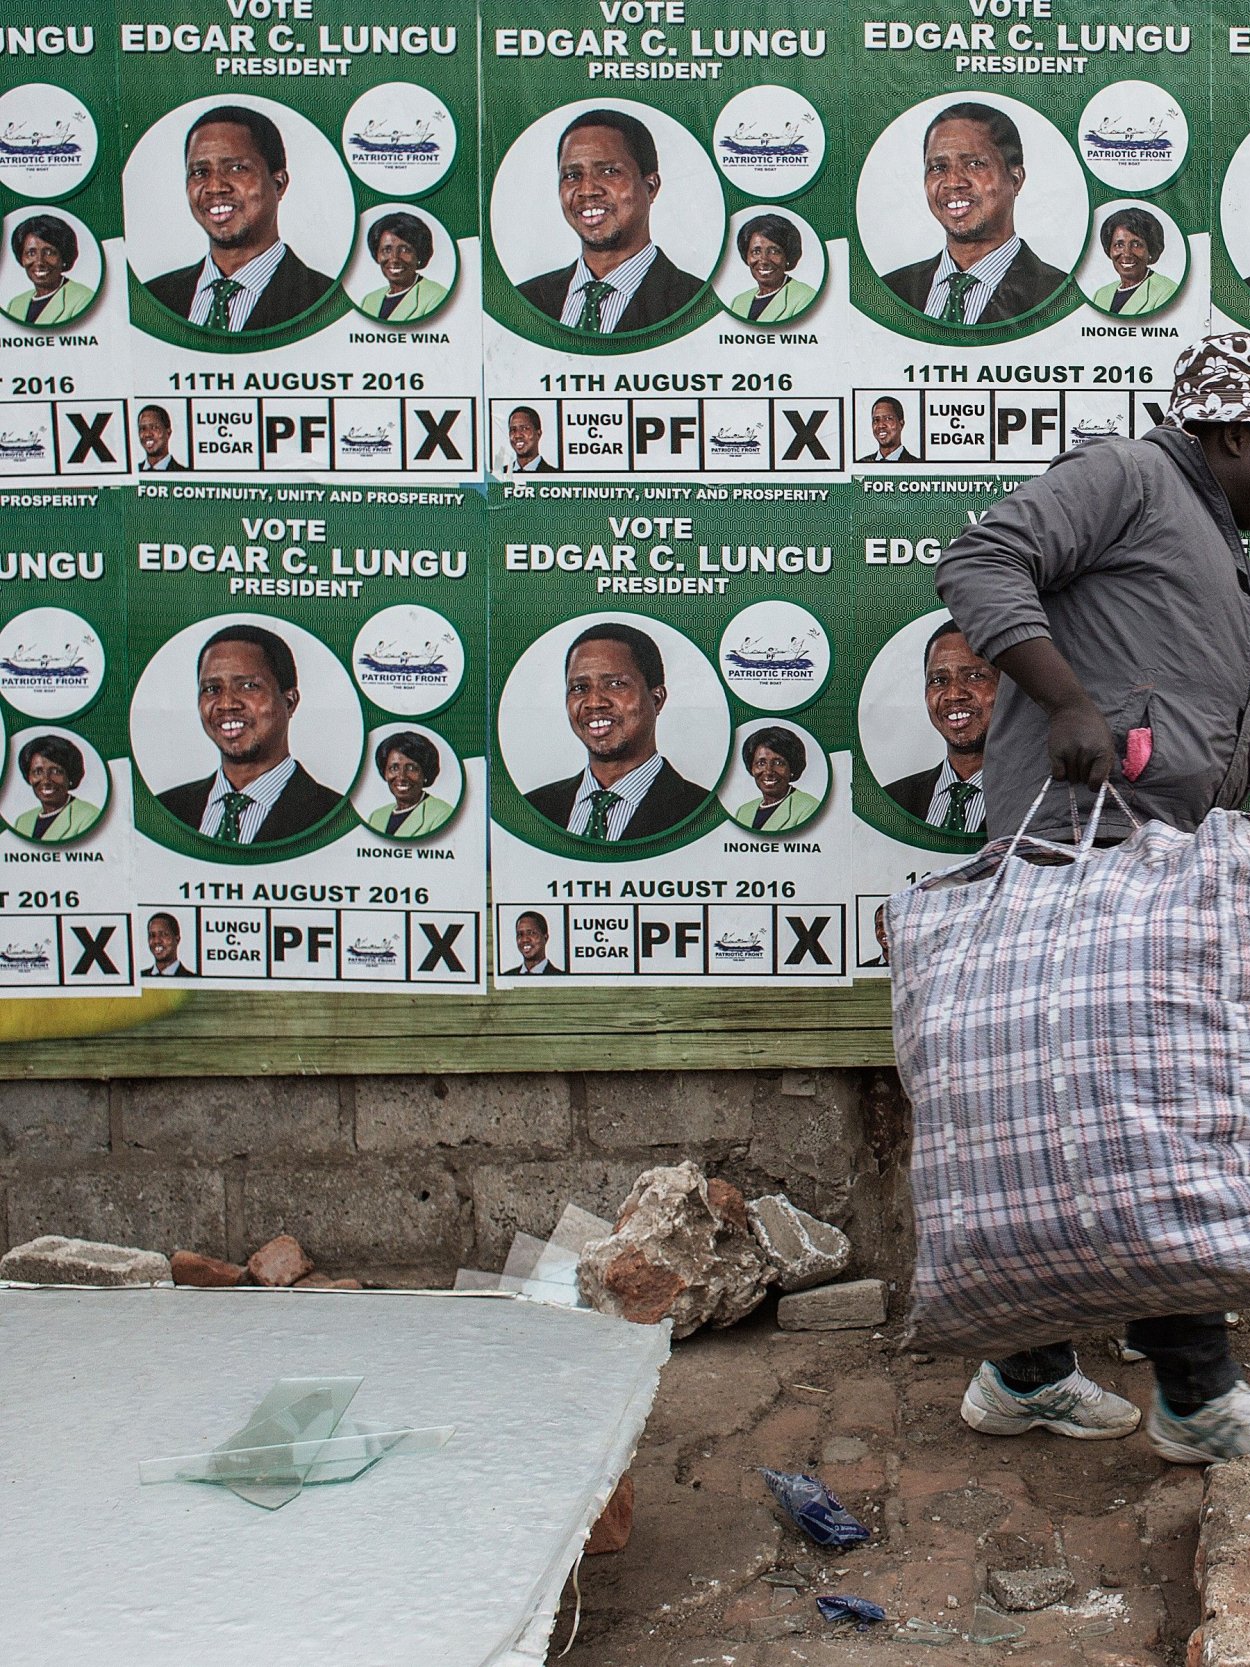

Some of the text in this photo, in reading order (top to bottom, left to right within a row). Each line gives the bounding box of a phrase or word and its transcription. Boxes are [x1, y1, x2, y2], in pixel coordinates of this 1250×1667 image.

[226, 0, 311, 19] VOTE
[600, 1, 684, 23] VOTE
[968, 0, 1050, 18] VOTE
[122, 24, 454, 53] EDGAR C. LUNGU
[496, 30, 824, 55] EDGAR C. LUNGU
[865, 22, 1189, 51] EDGAR C. LUNGU
[217, 57, 351, 75] PRESIDENT
[590, 60, 722, 79] PRESIDENT
[957, 55, 1088, 72] PRESIDENT
[350, 333, 450, 343] INONGE WINA
[1082, 327, 1179, 336] INONGE WINA
[170, 373, 424, 391] 11TH AUGUST 2016
[541, 374, 792, 392] 11TH AUGUST 2016
[904, 366, 1153, 384] 11TH AUGUST 2016
[568, 414, 622, 426] LUNGU
[65, 413, 116, 463] X
[267, 416, 327, 452] PF
[588, 426, 602, 438] C.
[637, 417, 697, 453] PF
[782, 411, 831, 460] X
[569, 443, 623, 454] EDGAR
[138, 486, 465, 504] FOR CONTINUITY, UNITY AND PROSPERITY
[242, 518, 325, 540] VOTE
[609, 517, 691, 538] VOTE
[139, 544, 465, 576] EDGAR C. LUNGU
[506, 544, 830, 571] EDGAR C. LUNGU
[231, 578, 363, 596] PRESIDENT
[598, 576, 729, 593] PRESIDENT
[724, 843, 821, 852] INONGE WINA
[180, 883, 428, 905] 11TH AUGUST 2016
[548, 881, 795, 898] 11TH AUGUST 2016
[206, 921, 260, 933] LUNGU
[226, 934, 240, 945] C.
[274, 926, 334, 962] PF
[642, 922, 701, 957] PF
[784, 917, 832, 964] X
[69, 927, 119, 975] X
[207, 949, 260, 960] EDGAR
